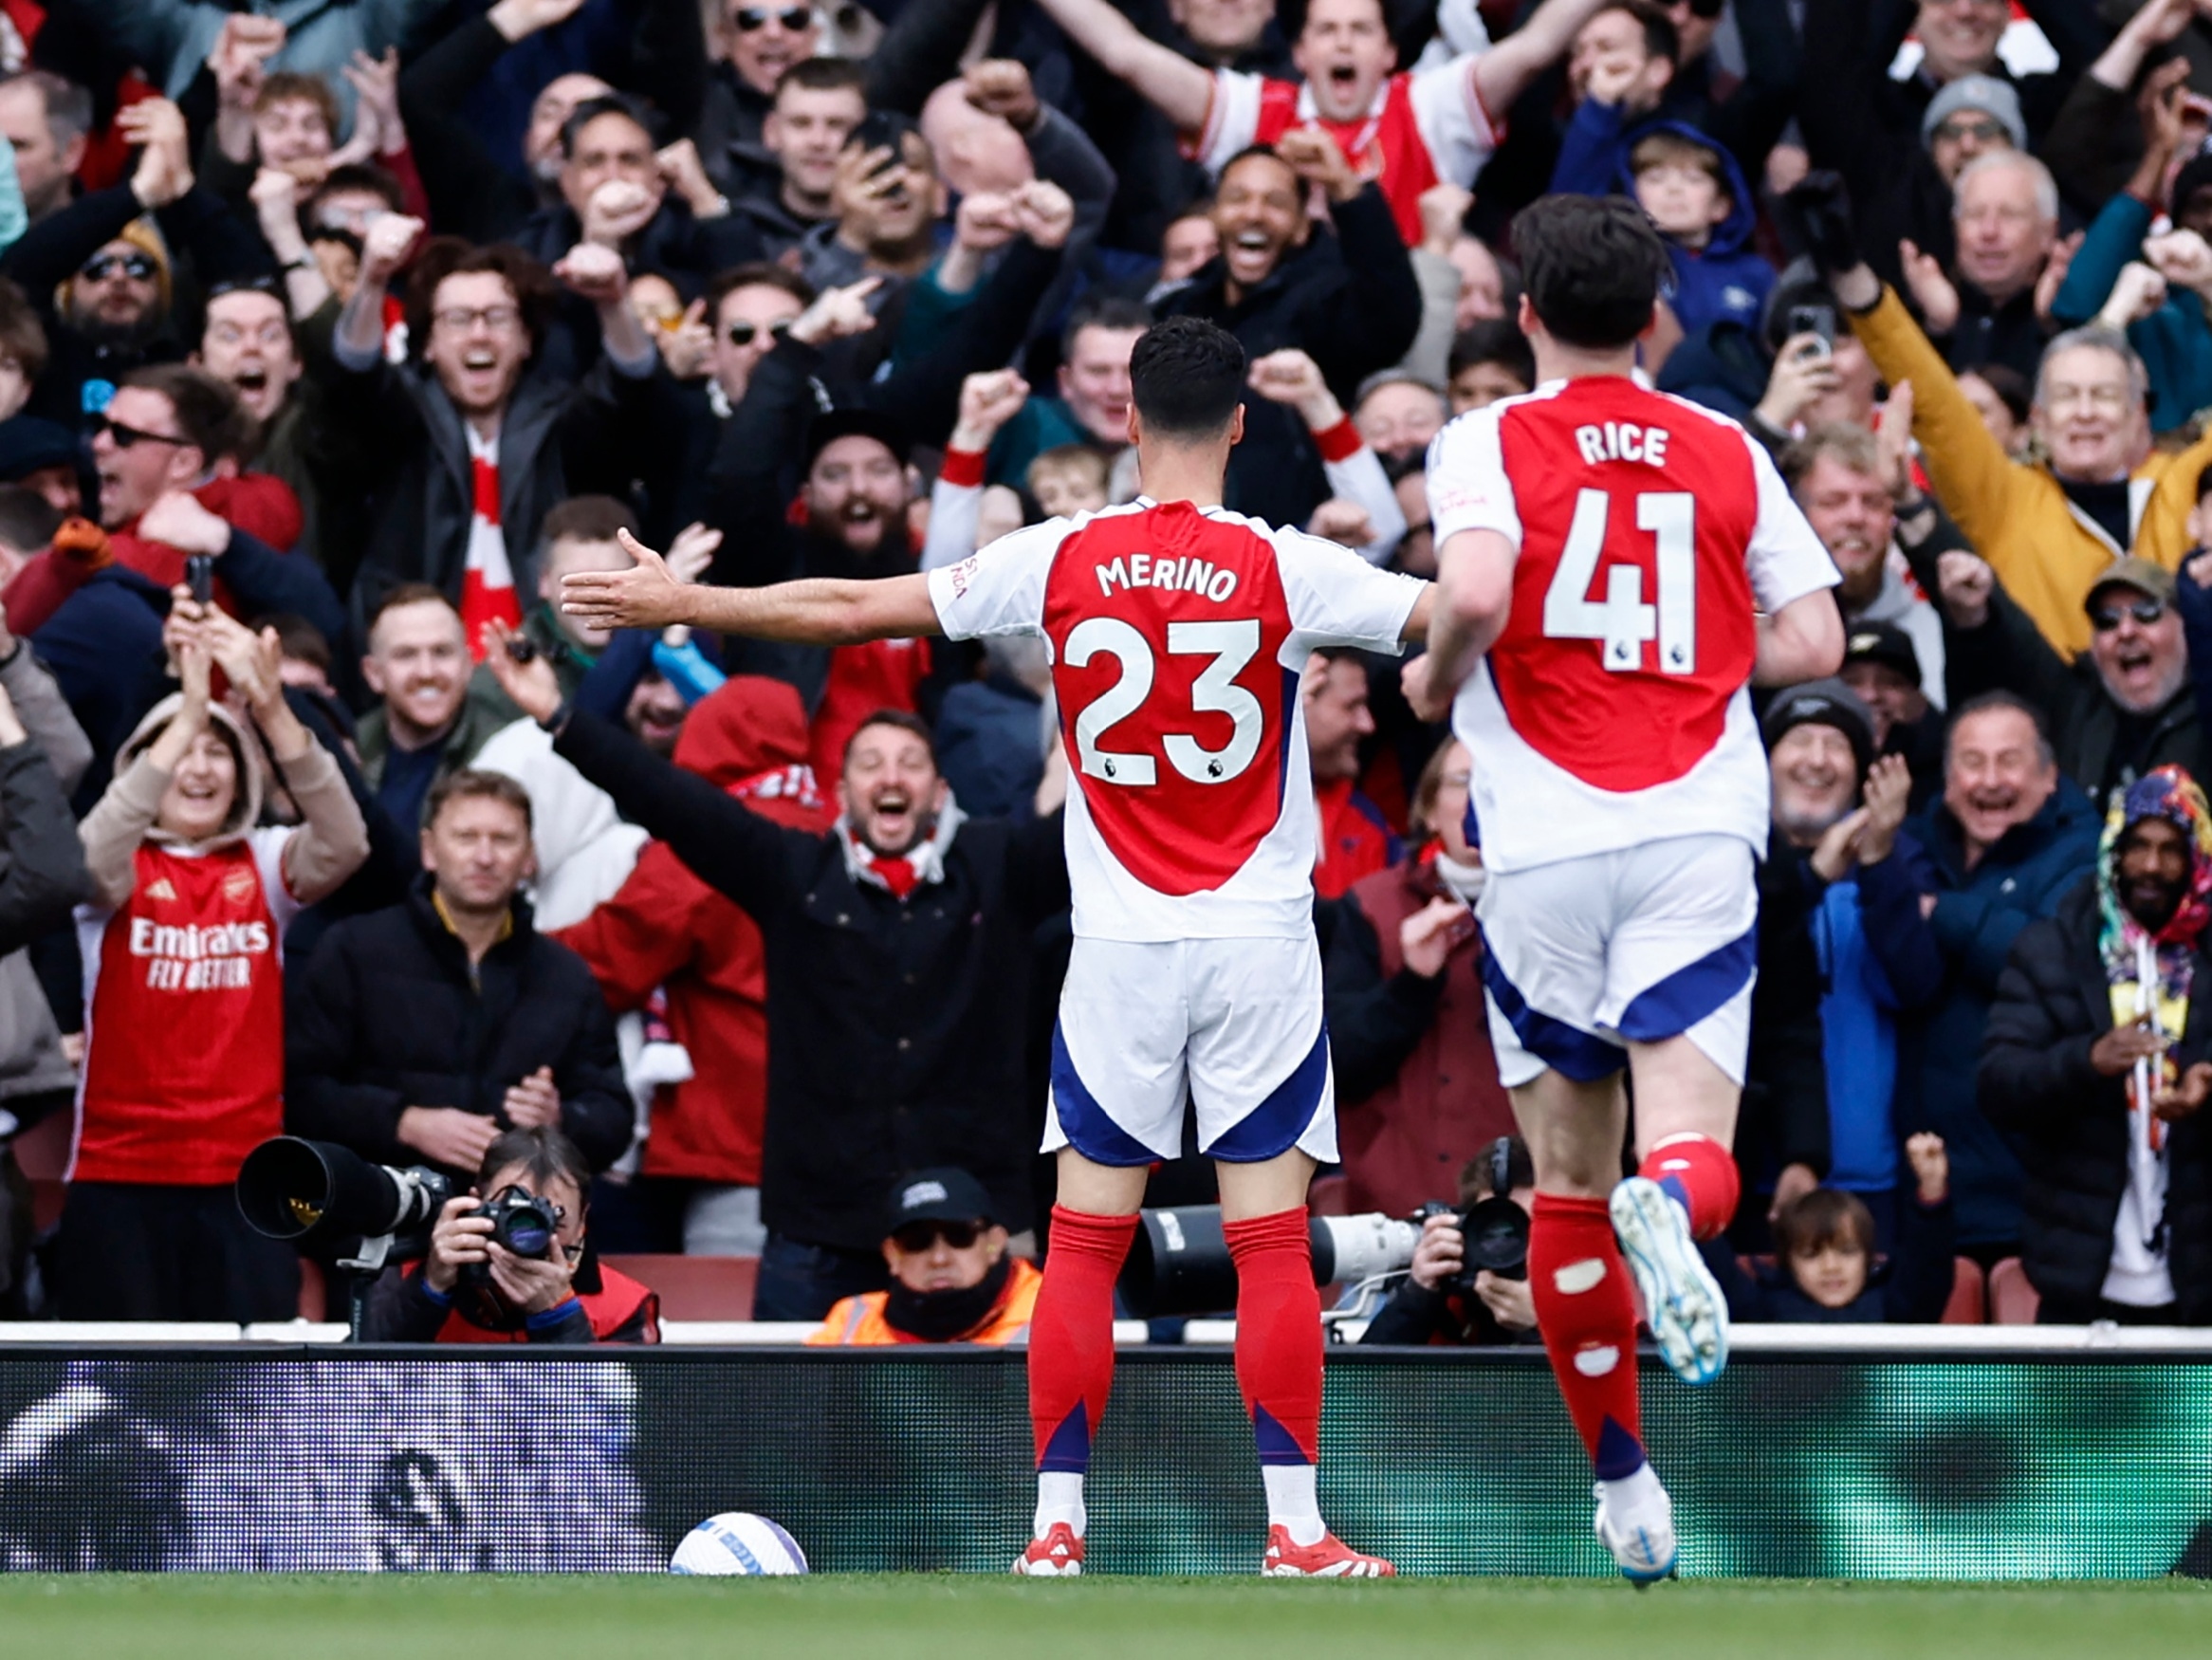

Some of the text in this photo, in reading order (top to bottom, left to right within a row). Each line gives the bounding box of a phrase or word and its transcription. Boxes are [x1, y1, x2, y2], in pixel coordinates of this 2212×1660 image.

[1575, 421, 1669, 468] RICE
[1095, 553, 1237, 603] MERINO
[1542, 486, 1696, 676] 41
[1063, 616, 1263, 785] 23
